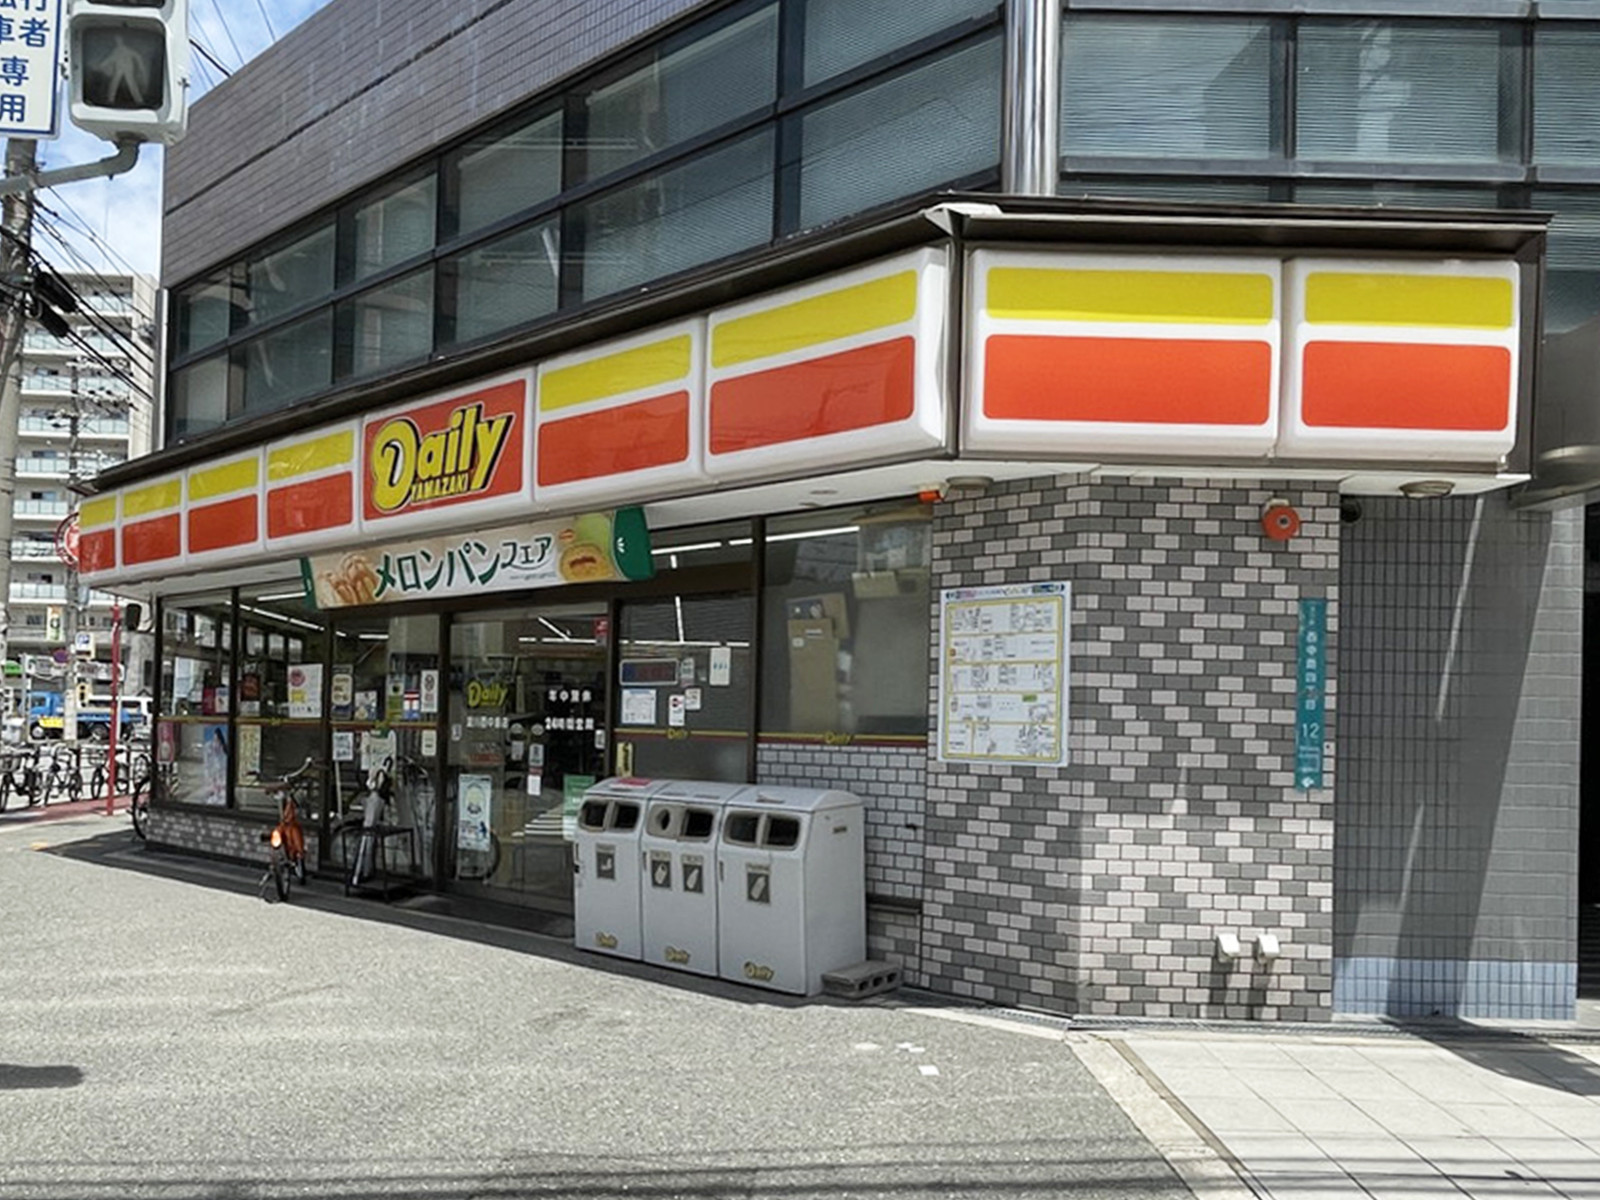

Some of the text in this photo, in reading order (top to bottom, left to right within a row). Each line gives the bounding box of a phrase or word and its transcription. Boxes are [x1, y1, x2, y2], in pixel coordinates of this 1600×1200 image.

[372, 402, 515, 511] Daily
[411, 472, 470, 502] YAMAZAKI
[375, 537, 552, 598] メロンパンフェア
[468, 680, 508, 708] Daily
[1302, 722, 1320, 739] 12
